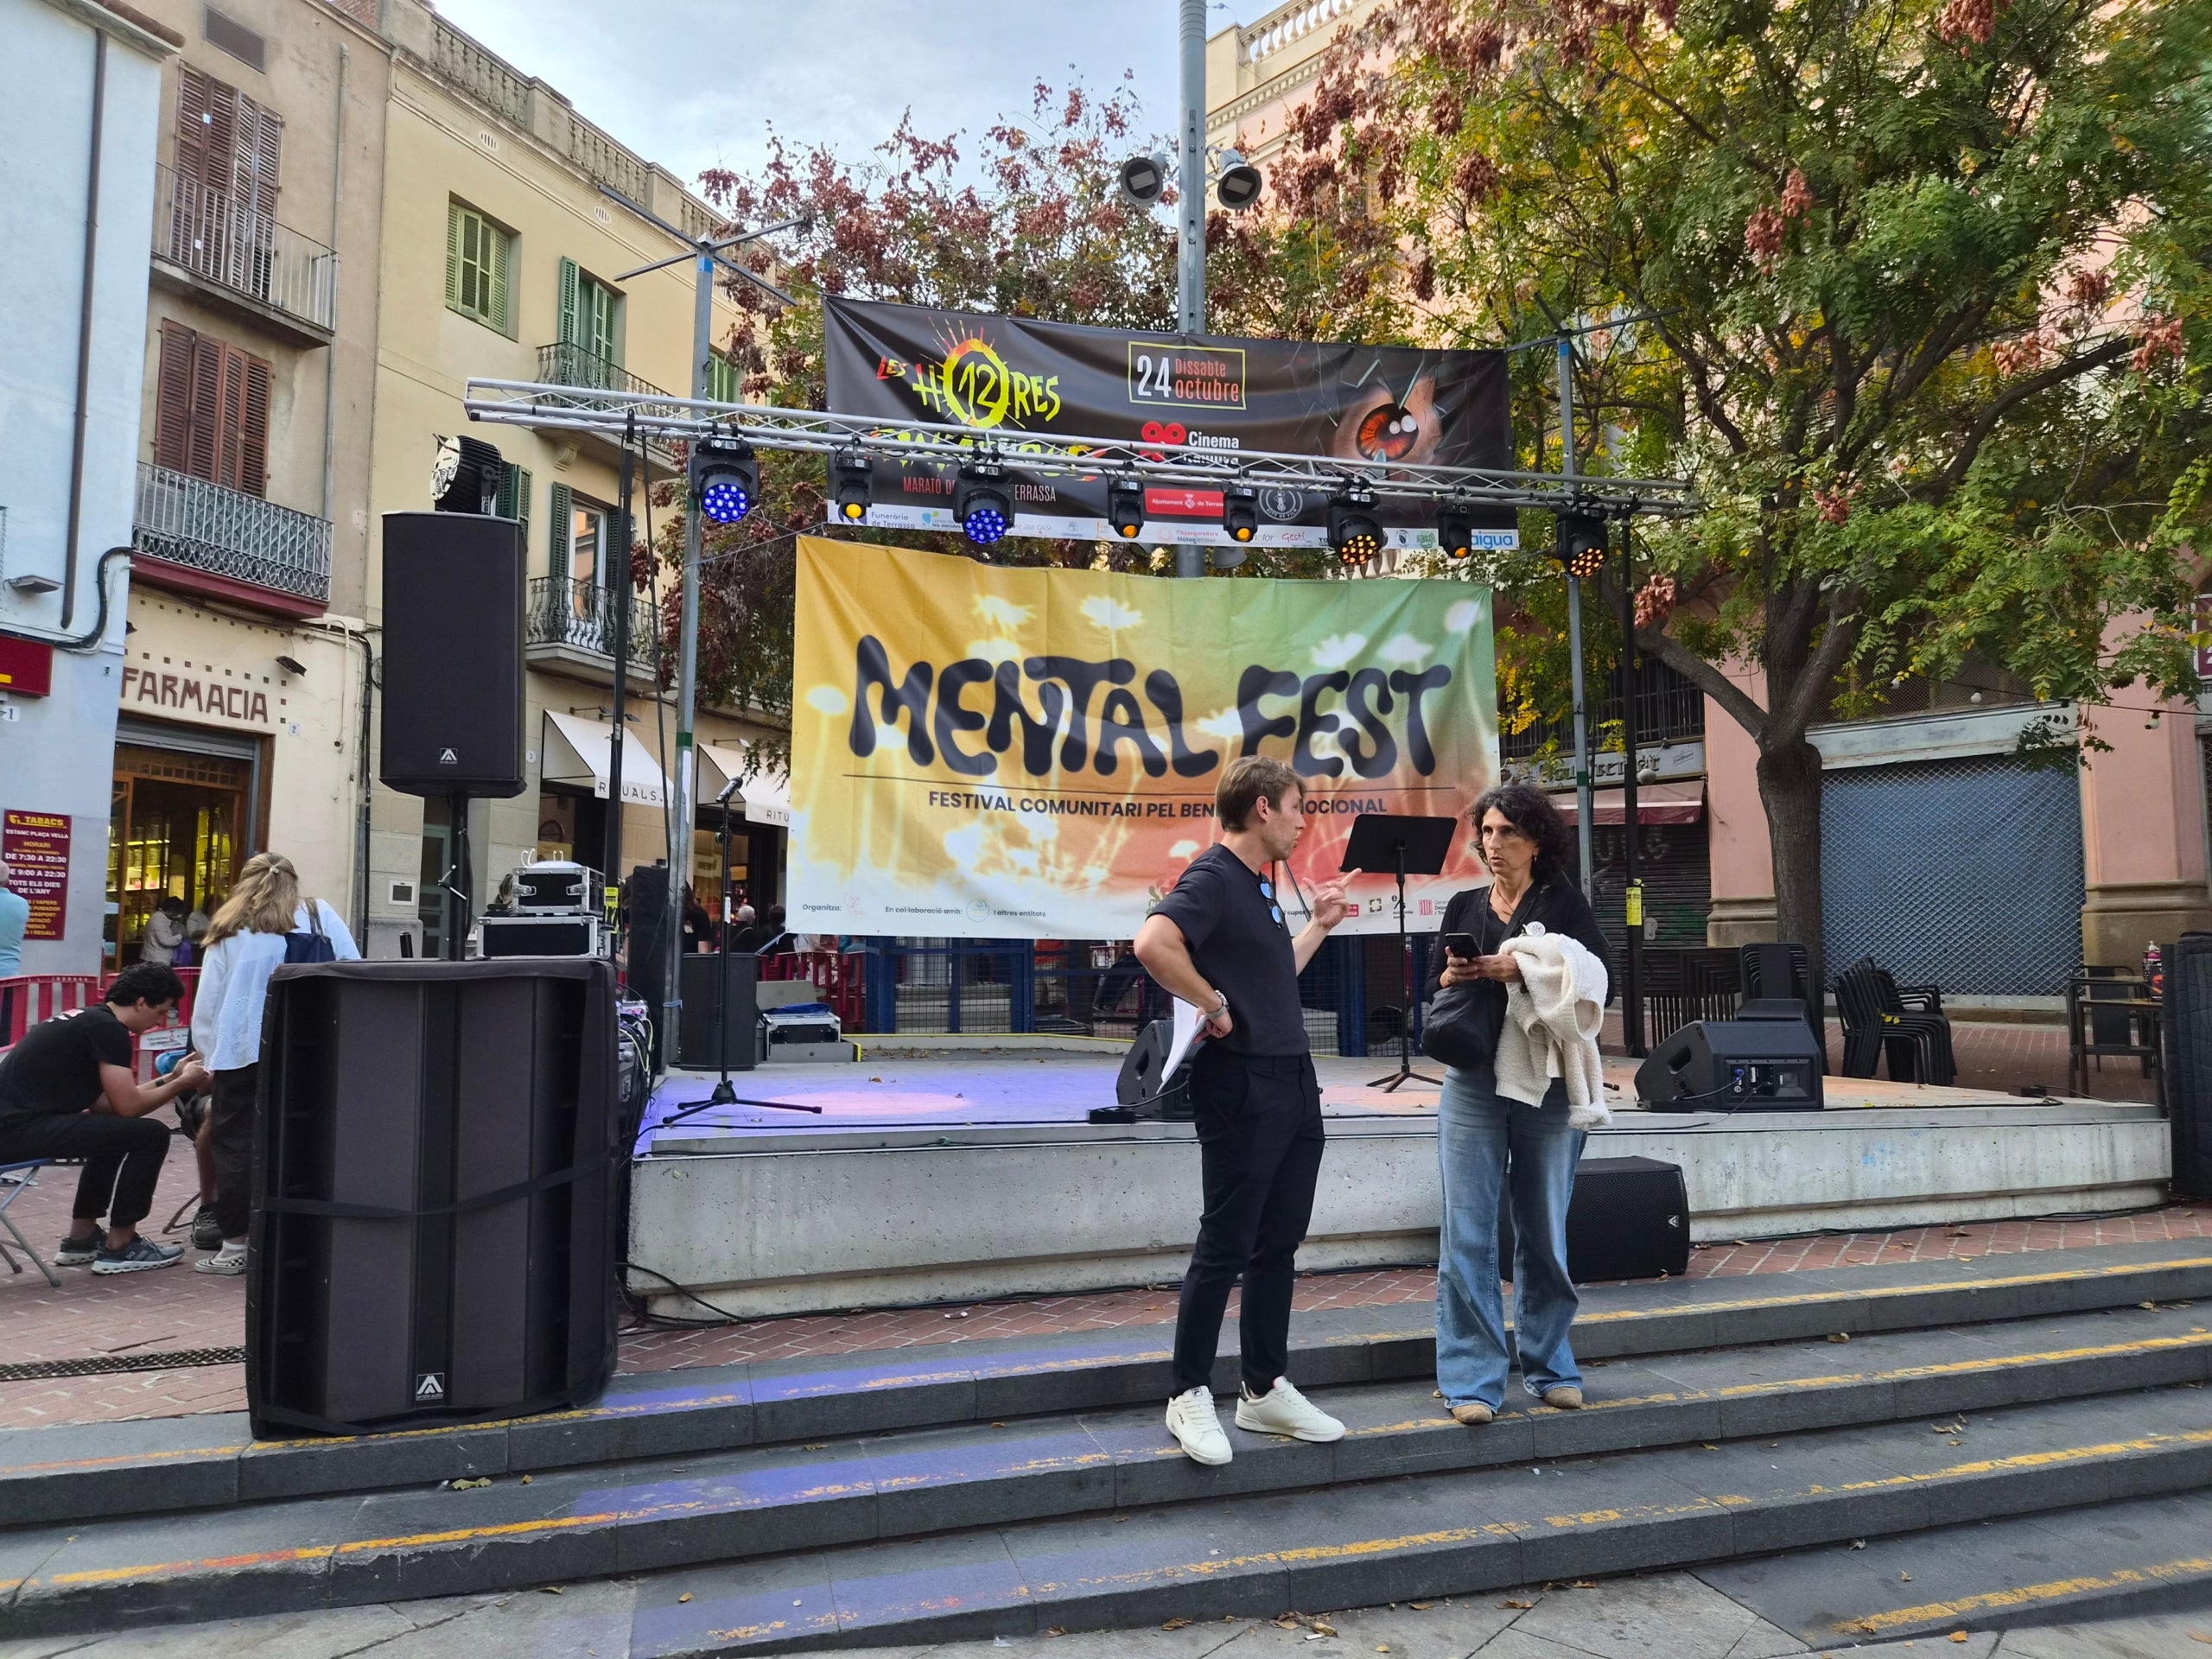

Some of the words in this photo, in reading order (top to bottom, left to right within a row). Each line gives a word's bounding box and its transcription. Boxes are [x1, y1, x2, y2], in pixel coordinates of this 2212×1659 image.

[876, 355, 907, 380] LES
[1136, 354, 1172, 398] 24
[1175, 357, 1227, 378] Dissabte
[957, 359, 999, 412] 12
[1174, 378, 1240, 403] octubre
[1188, 431, 1240, 449] Cinema
[1014, 484, 1057, 503] ERRASSA
[883, 520, 916, 529] Terrassa
[1471, 532, 1513, 550] aigua
[121, 666, 269, 723] FARMACIA
[848, 634, 1219, 779] MENTAL
[1237, 663, 1452, 779] FEST
[929, 790, 1016, 812] FESTIVAL
[1020, 798, 1141, 818] COMUNITARI
[1147, 803, 1176, 817] PEL
[1180, 803, 1215, 818] BEN
[1303, 798, 1388, 815] OCIONAL
[24, 816, 64, 826] TABACS
[766, 810, 790, 823] RITU
[802, 903, 842, 912] Organitza:
